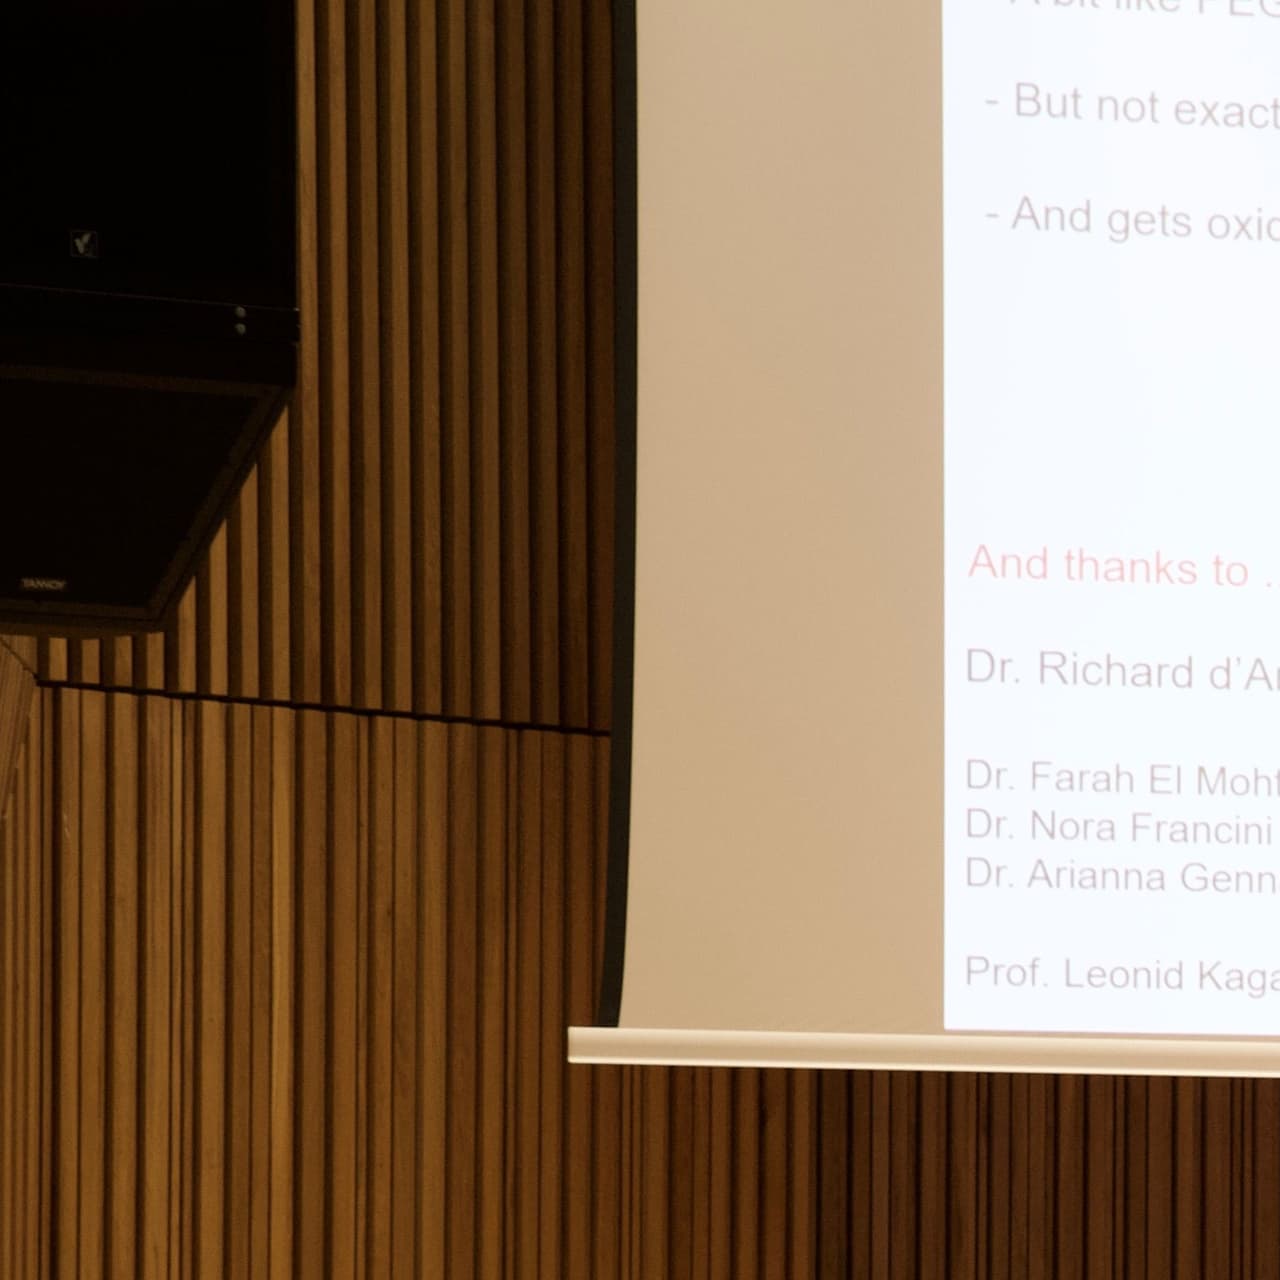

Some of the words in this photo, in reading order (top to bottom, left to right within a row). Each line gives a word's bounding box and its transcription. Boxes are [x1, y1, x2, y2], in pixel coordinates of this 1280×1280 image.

[1015, 81, 1083, 120] But
[1097, 91, 1160, 124] not
[1011, 195, 1091, 233] And
[1107, 204, 1193, 244] gets
[967, 543, 1049, 580] And
[1063, 547, 1198, 585] thanks
[1211, 554, 1249, 588] to
[967, 647, 1020, 684] Dr.
[1039, 650, 1193, 689] Richard
[966, 758, 1015, 791] Dr.
[1031, 760, 1134, 793] Farah
[1149, 763, 1182, 795] El
[966, 807, 1014, 840] Dr.
[1031, 809, 1116, 842] Nora
[1131, 811, 1272, 846] Francini
[966, 855, 1014, 889] Dr.
[1027, 858, 1166, 891] Arianna
[965, 955, 1049, 987] Prof.
[1064, 957, 1184, 991] Leonid
